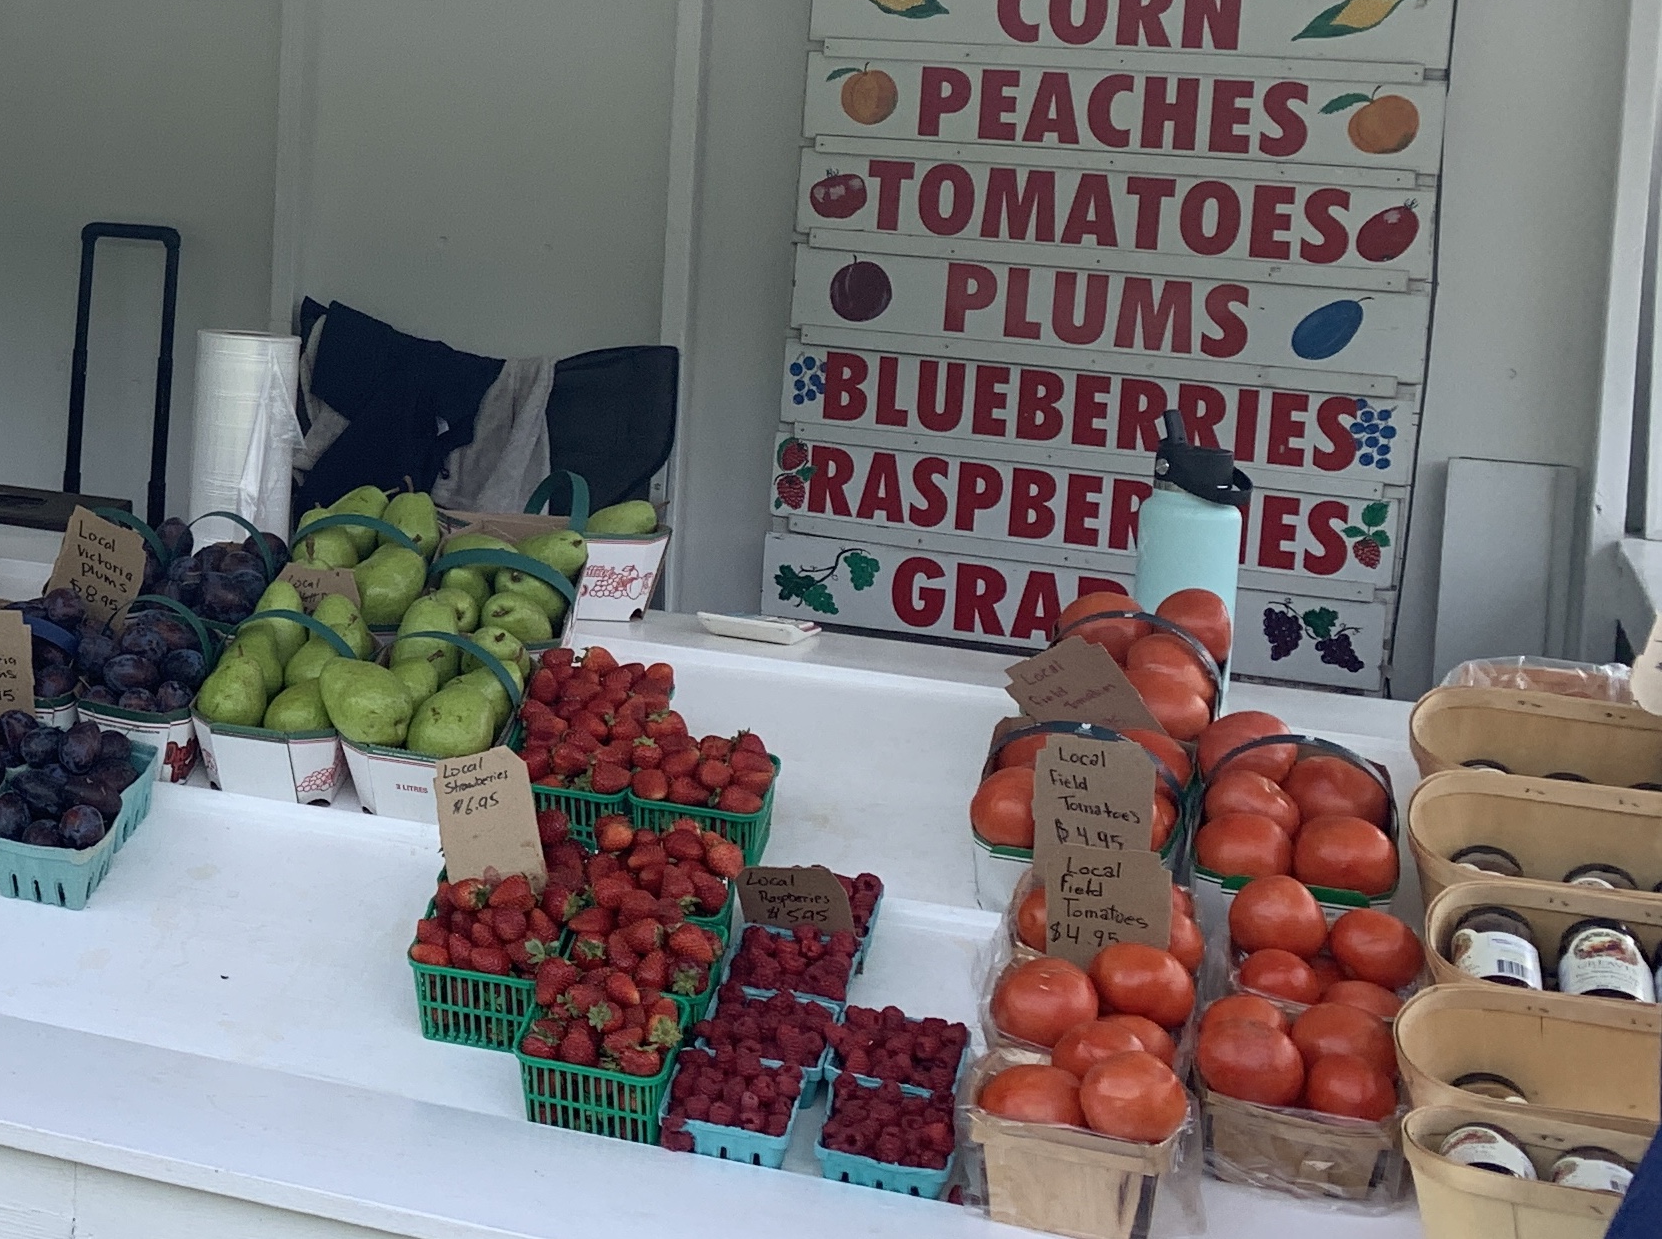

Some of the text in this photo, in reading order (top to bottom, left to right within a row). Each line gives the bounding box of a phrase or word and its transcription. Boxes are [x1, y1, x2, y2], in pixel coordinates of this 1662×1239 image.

[917, 66, 1310, 157] PEACHES
[869, 159, 1354, 264] TOMATOES
[944, 262, 1249, 358] PLUMS
[822, 351, 1359, 471] BLUEBERRIES
[79, 520, 115, 552] Local
[78, 544, 133, 582] Victoria
[1020, 659, 1065, 686] Local
[443, 757, 483, 779] Local
[1059, 747, 1106, 768] Local
[444, 770, 508, 795] Strawberries
[1049, 768, 1088, 791] Field
[452, 791, 499, 815] $6.95
[1058, 795, 1141, 824] Tomatoes
[746, 872, 795, 887] Local
[1066, 856, 1122, 879] Local
[1060, 873, 1103, 898] Field
[758, 890, 830, 908] Raspberries
[1063, 897, 1149, 929] Tomatoes
